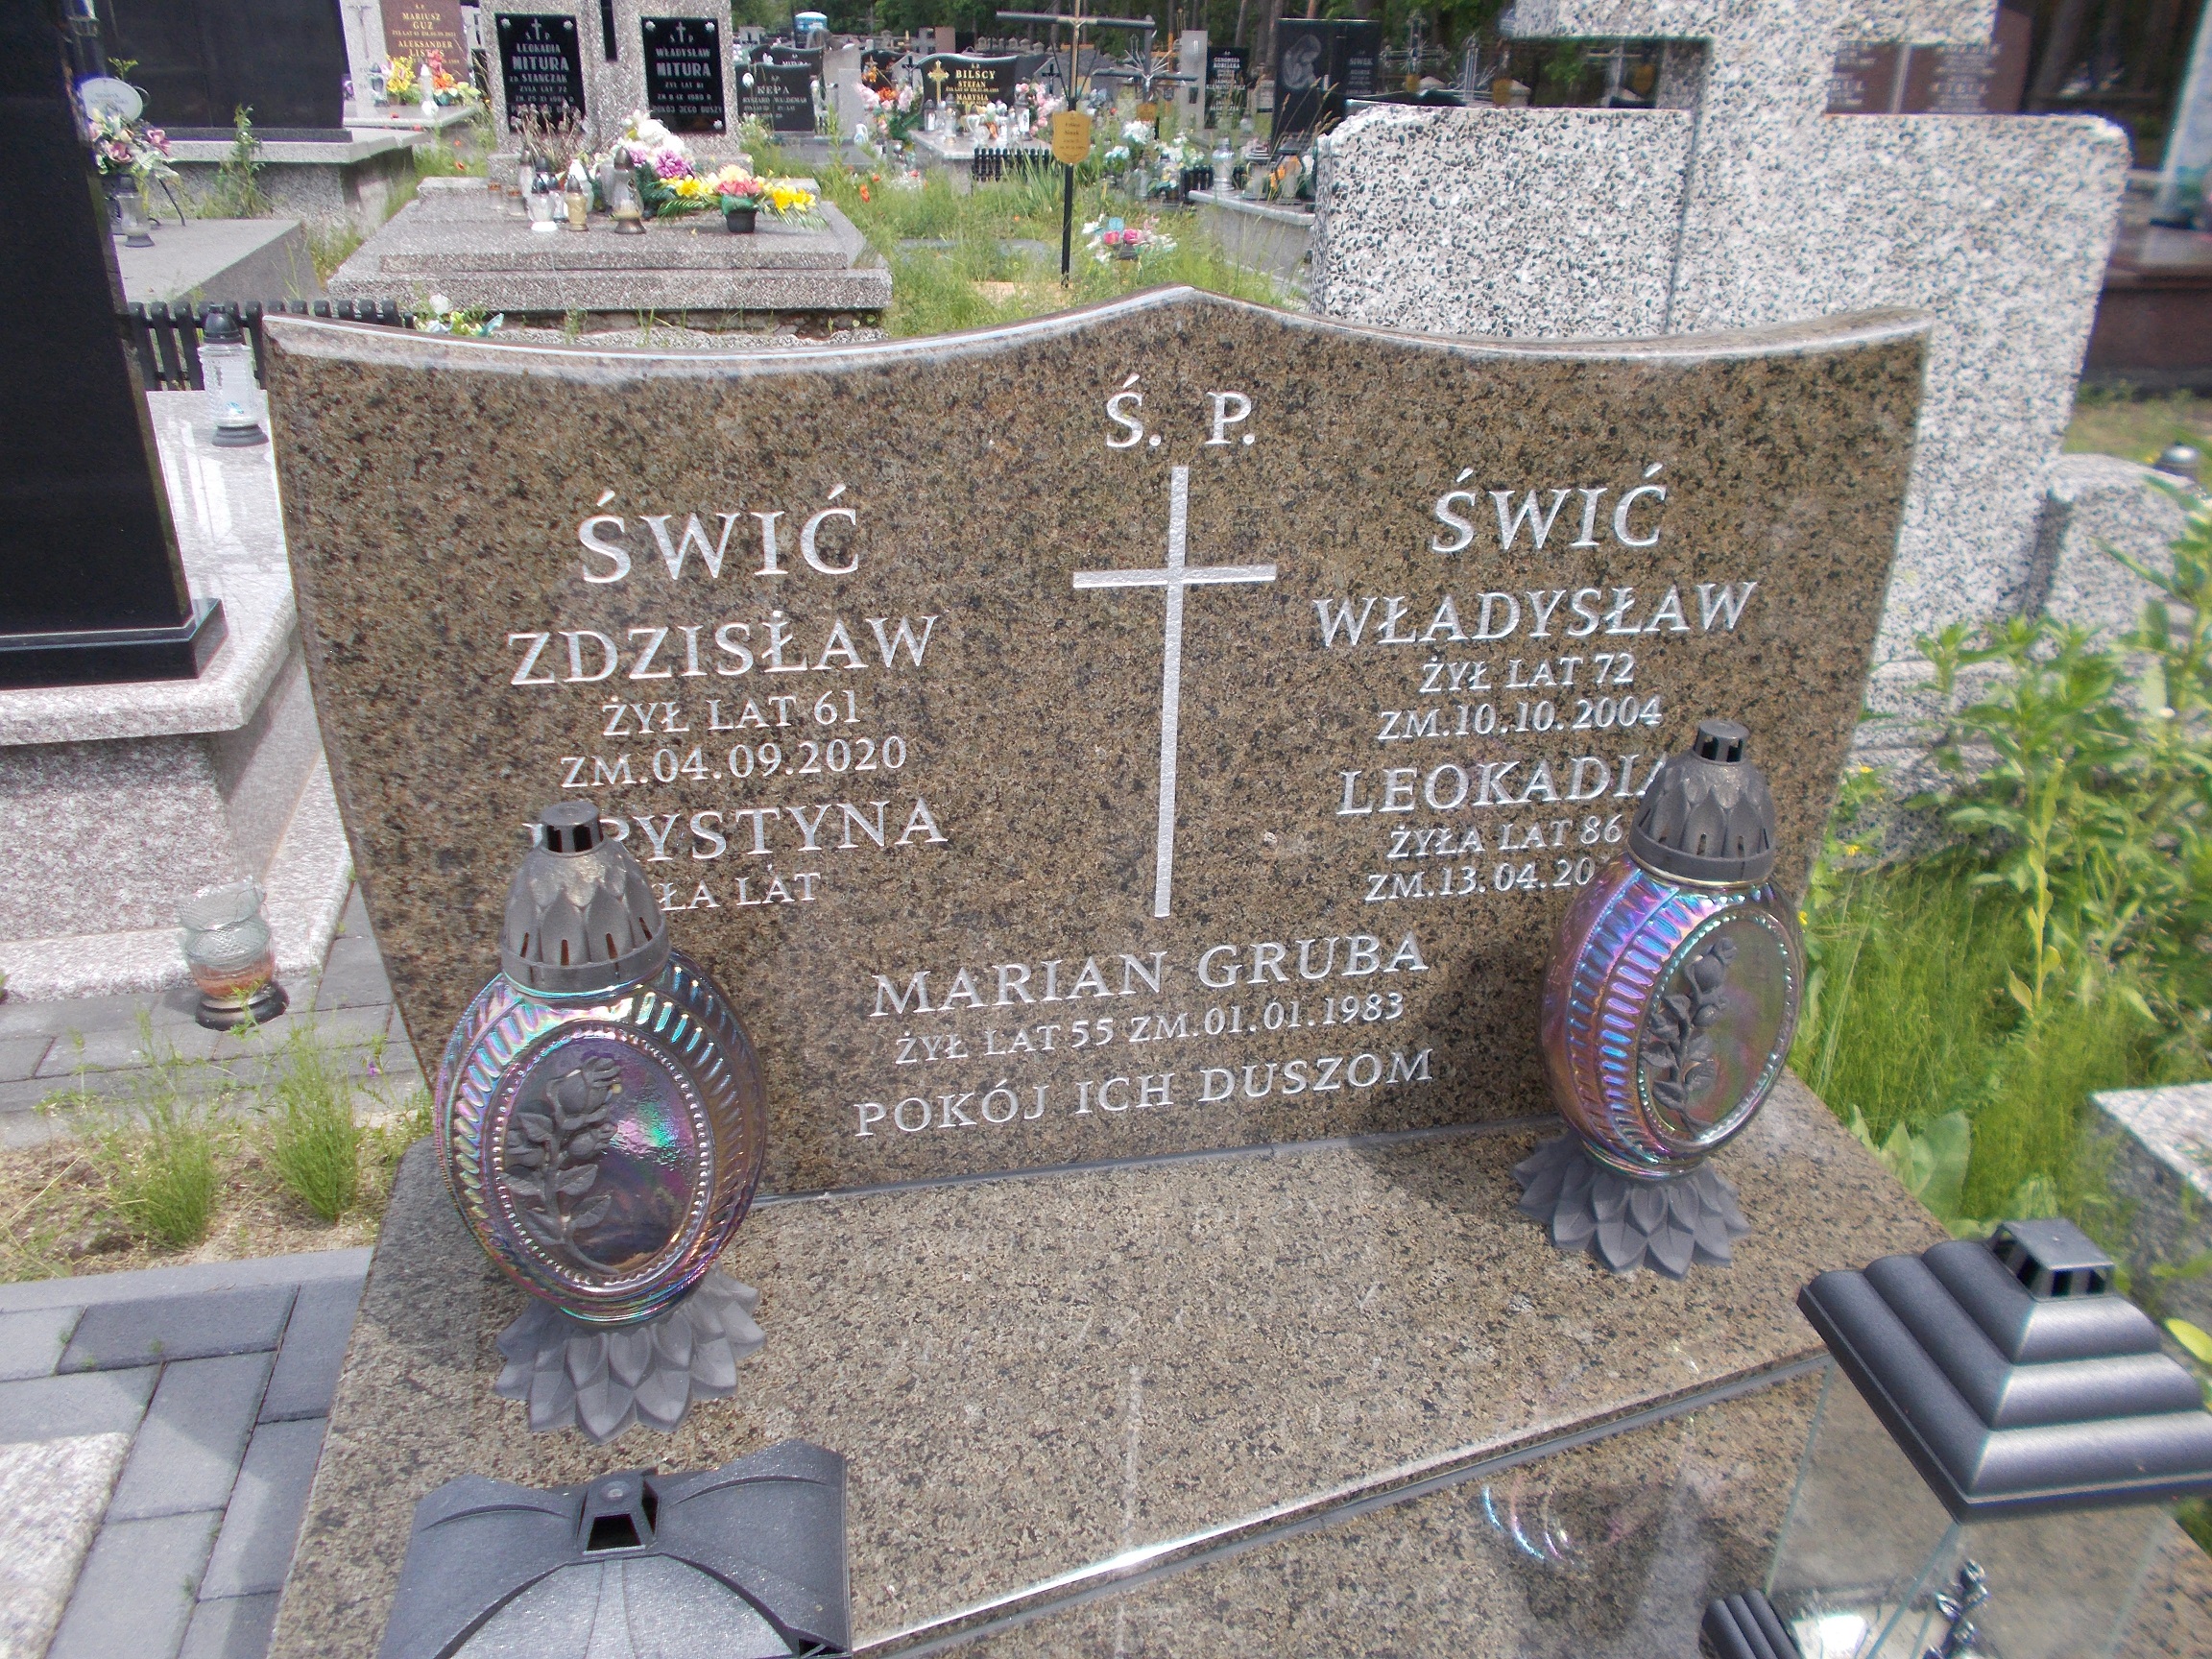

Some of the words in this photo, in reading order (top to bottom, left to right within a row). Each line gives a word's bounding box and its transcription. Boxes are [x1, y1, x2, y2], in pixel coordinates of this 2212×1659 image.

[413, 21, 434, 30] GUZ
[517, 43, 561, 53] LEOKADIA
[512, 57, 569, 71] MITURA
[655, 47, 710, 58] WŁADYSŁAW
[656, 62, 711, 77] MITURA
[955, 69, 996, 80] BILSCY
[1204, 390, 1256, 445] P.
[1431, 462, 1668, 553] ŚWIĆ
[578, 483, 859, 584] ŚWIĆ
[1311, 581, 1758, 648] WŁADYSŁAW
[507, 613, 939, 685] ZDZISŁAW
[1419, 654, 1491, 693] ŻYŁ
[1505, 657, 1583, 688] LAT
[1595, 652, 1634, 685] 72
[601, 695, 689, 736] ŻYŁ
[706, 695, 797, 731] LAT
[814, 689, 861, 725] 61
[560, 734, 907, 788] ZM.04.09.2020
[521, 798, 950, 863] YSTYNA
[1386, 824, 1485, 859] ŻYŁA
[1498, 818, 1574, 853] LAT
[1579, 813, 1623, 844] 86
[734, 871, 822, 907] LAT
[868, 950, 1168, 1018] MARIAN
[1197, 931, 1430, 989] GRUBA
[895, 1031, 969, 1065] ŻYŁ
[984, 1024, 1061, 1056] LAT
[1070, 1018, 1114, 1048] 55
[1128, 992, 1405, 1044] ZM.01.01.1983
[853, 1078, 1050, 1137] POKÓJ
[1074, 1072, 1176, 1115] ICH
[1197, 1048, 1434, 1102] DUSZOM
